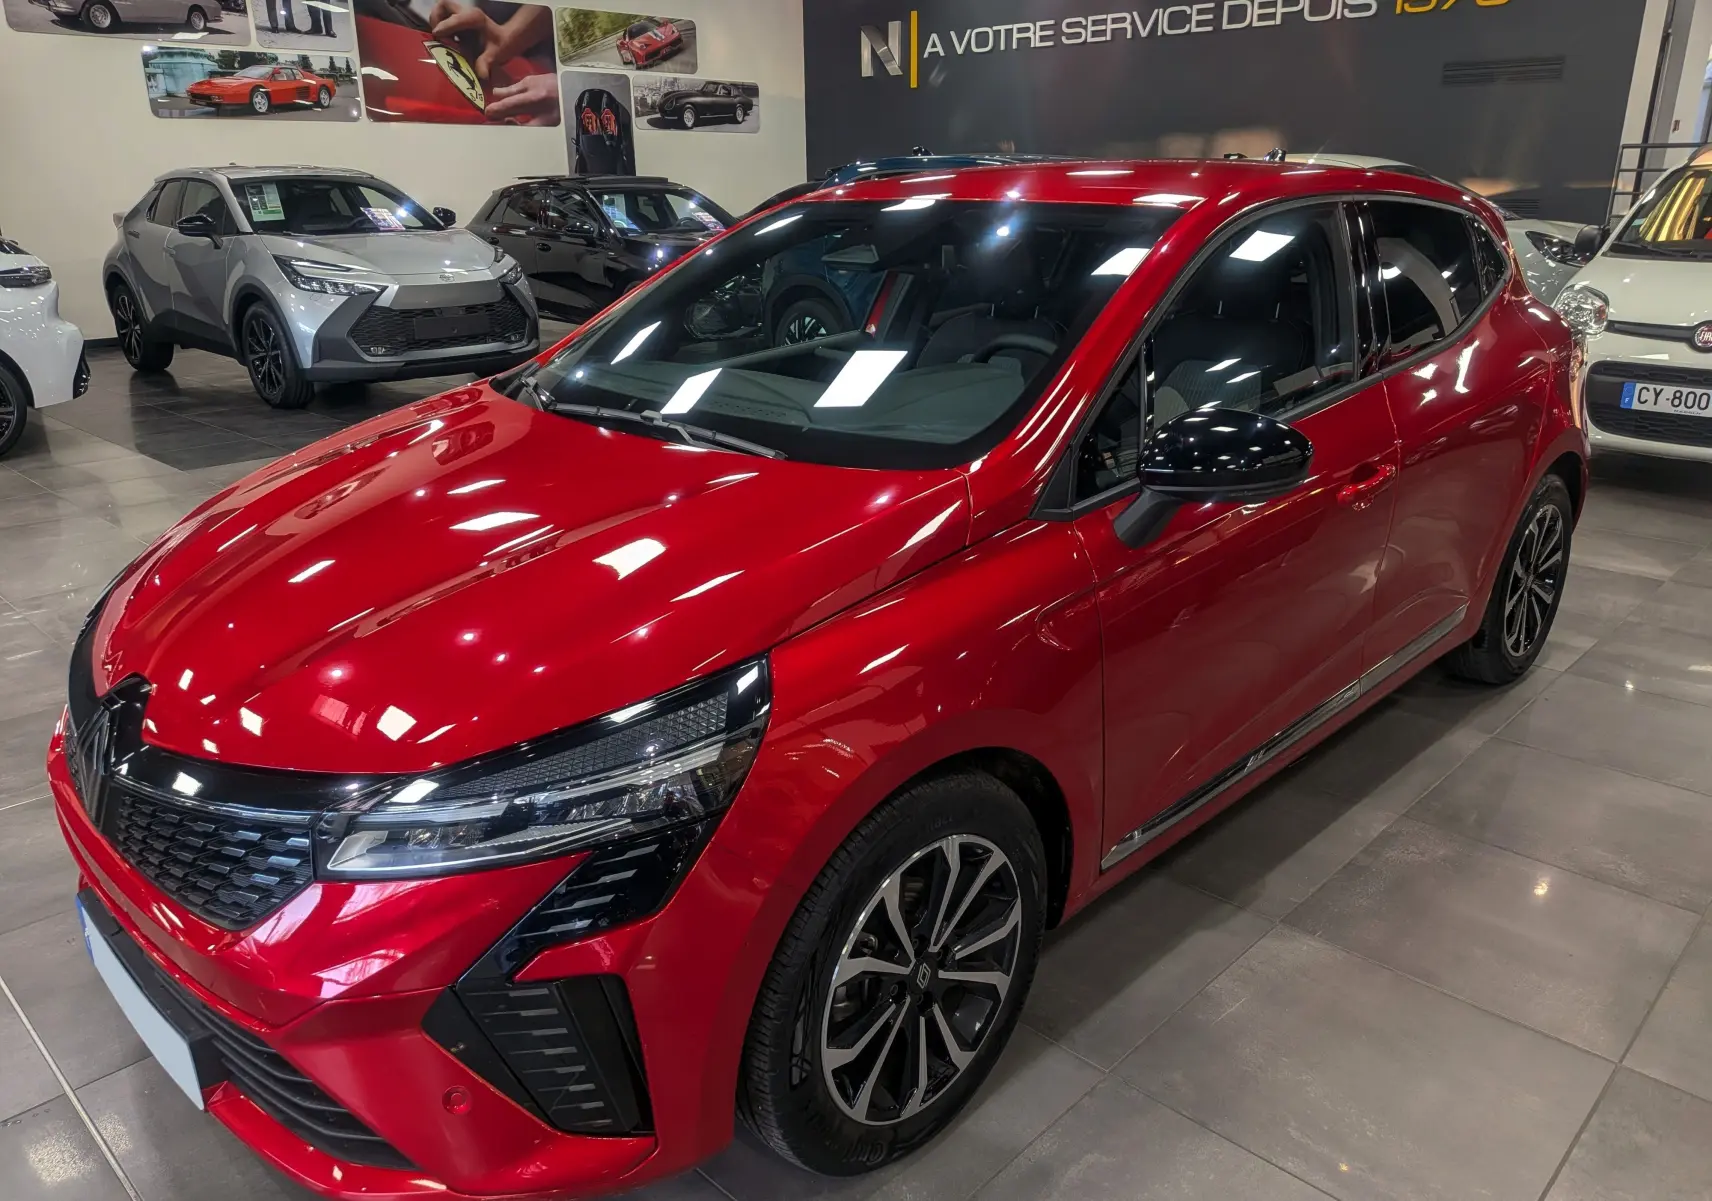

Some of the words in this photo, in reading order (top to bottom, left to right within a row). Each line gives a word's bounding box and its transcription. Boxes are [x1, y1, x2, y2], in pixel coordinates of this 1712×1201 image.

[860, 20, 903, 77] N
[923, 32, 946, 58] A
[949, 19, 1055, 55] VOTRE
[1061, 2, 1216, 45] SERVICE
[1221, 0, 1378, 30] DEPUIS
[1700, 331, 1712, 341] FIA
